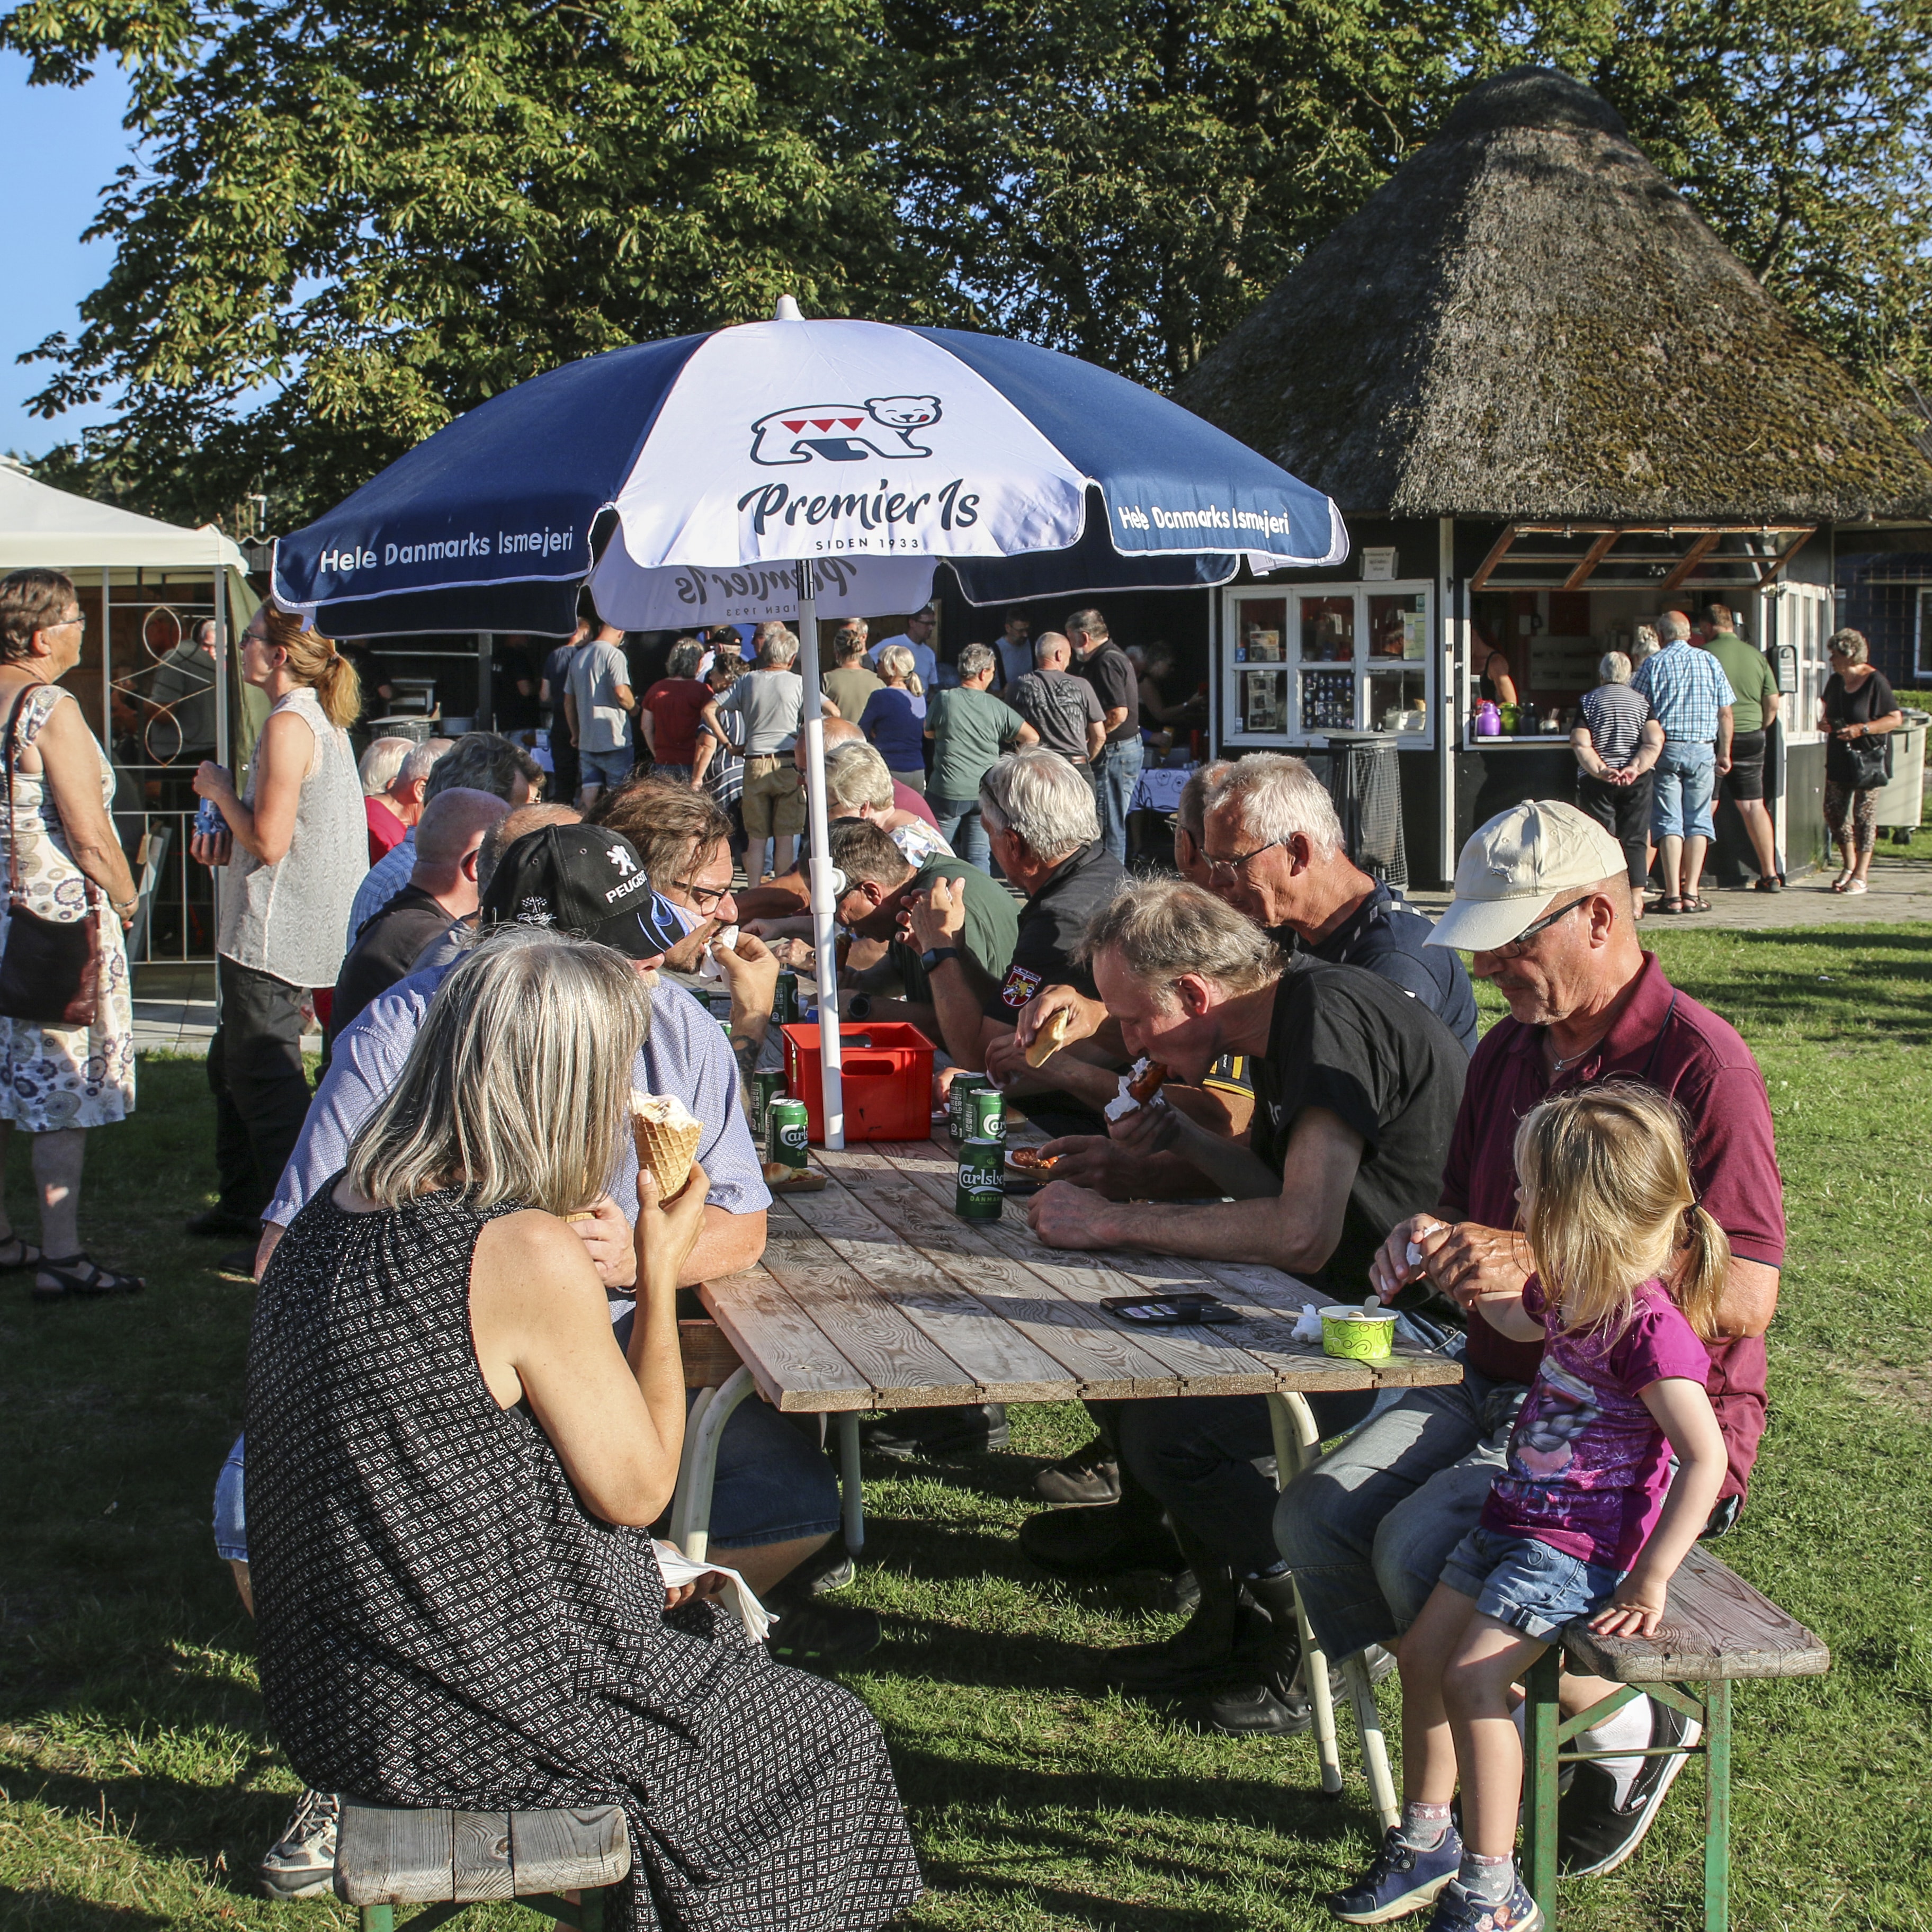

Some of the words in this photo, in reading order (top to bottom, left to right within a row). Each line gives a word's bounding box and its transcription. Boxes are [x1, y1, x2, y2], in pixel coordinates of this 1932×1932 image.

[737, 479, 931, 535] Premier
[938, 478, 980, 531] Is
[1151, 504, 1231, 529] Danmarks
[1232, 507, 1290, 539] Ismejeri
[320, 545, 377, 573] Hele
[385, 532, 490, 566] Danmarks
[499, 526, 573, 558] Ismejeri
[816, 538, 868, 550] SIDEN
[880, 539, 919, 549] 1933
[605, 870, 647, 904] PEUGEOT
